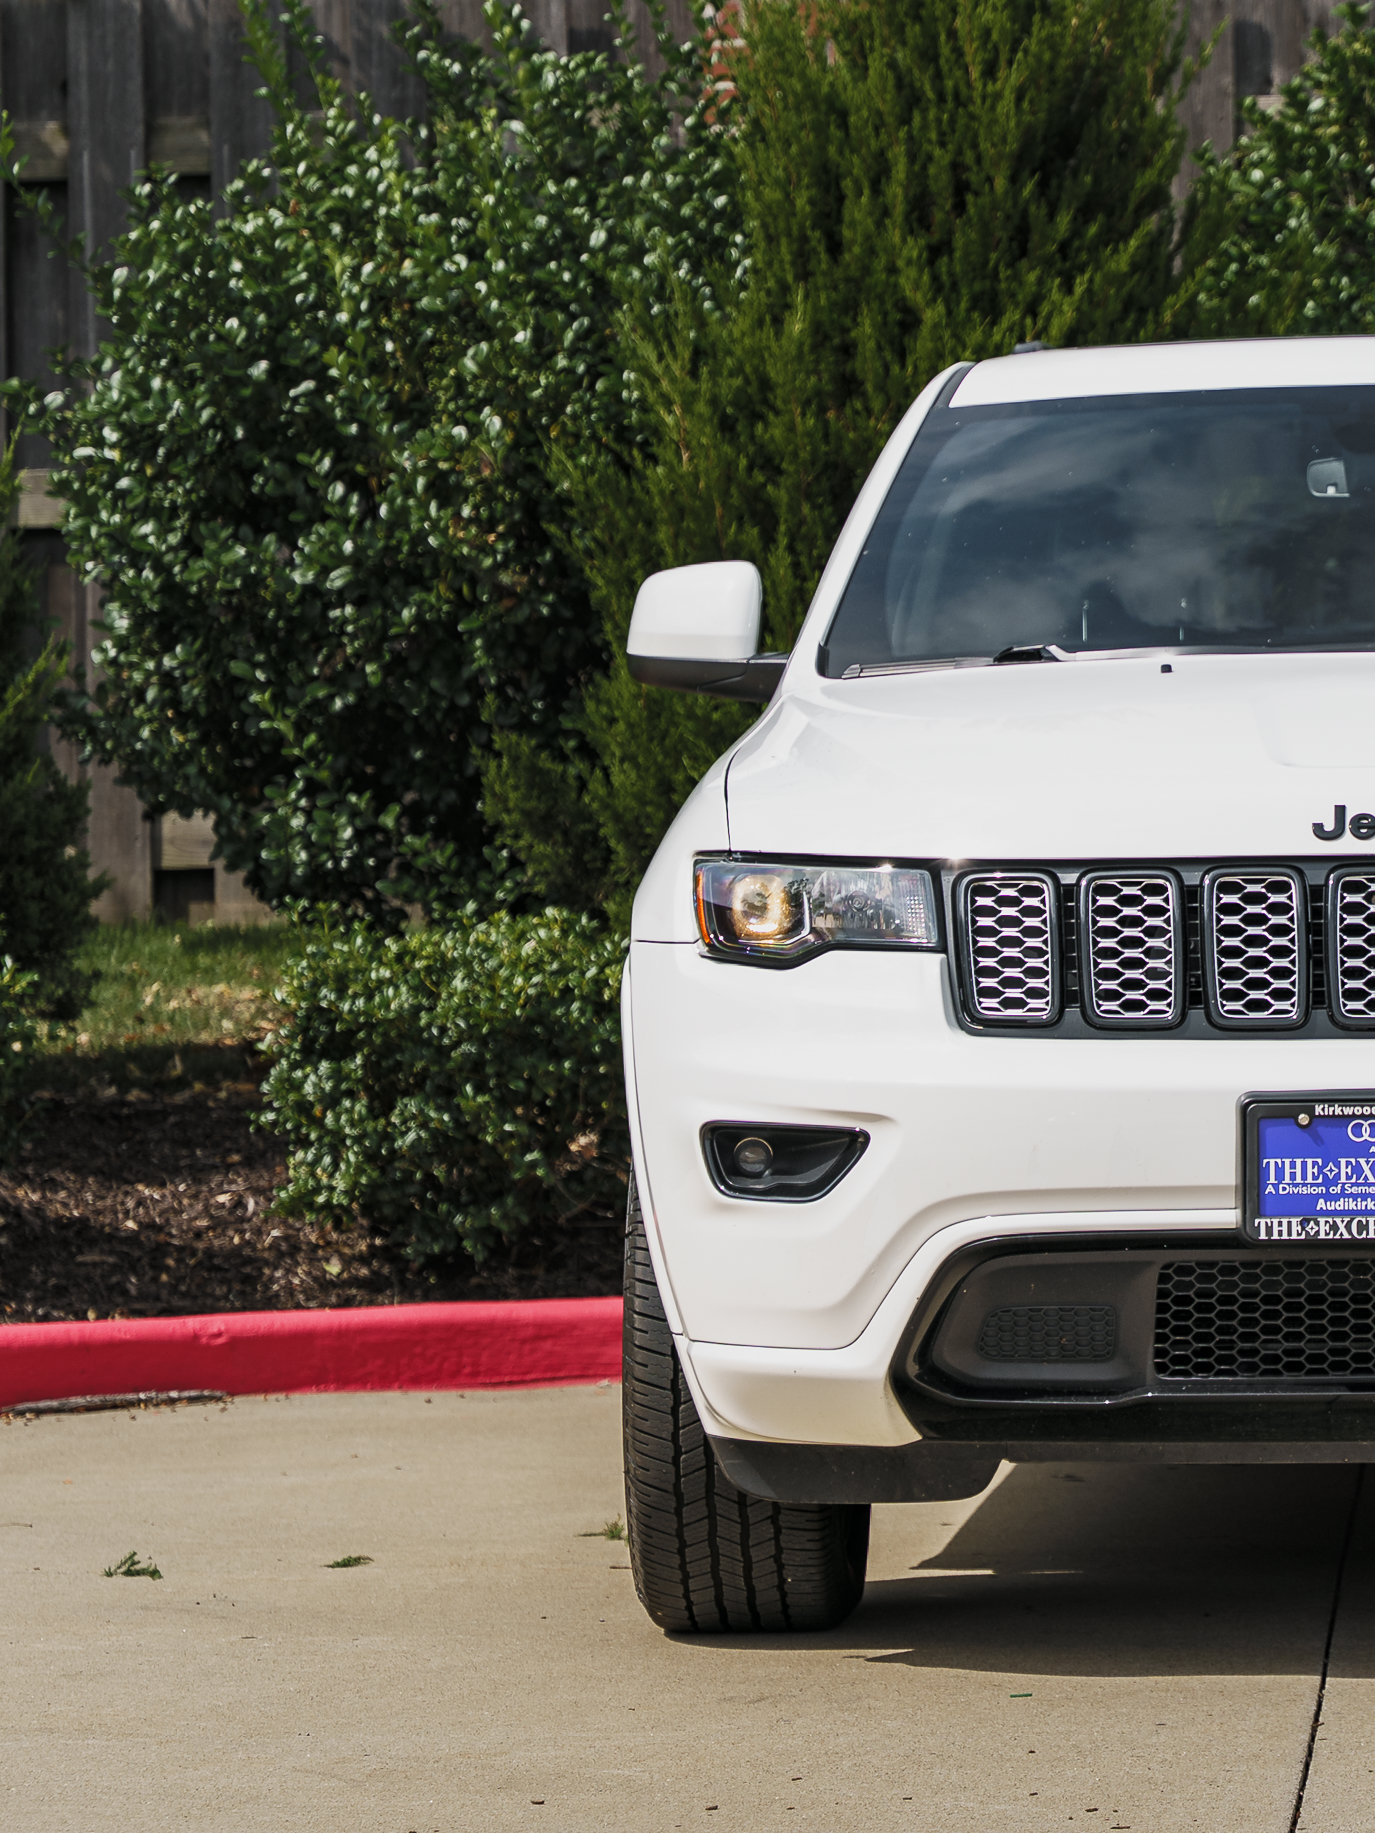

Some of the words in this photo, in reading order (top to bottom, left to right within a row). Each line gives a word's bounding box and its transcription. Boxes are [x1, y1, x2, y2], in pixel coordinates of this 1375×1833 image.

[1262, 1158, 1323, 1184] THE
[1264, 1185, 1275, 1194] A
[1278, 1184, 1326, 1194] Division
[1329, 1184, 1342, 1194] of
[1254, 1218, 1306, 1240] THE
